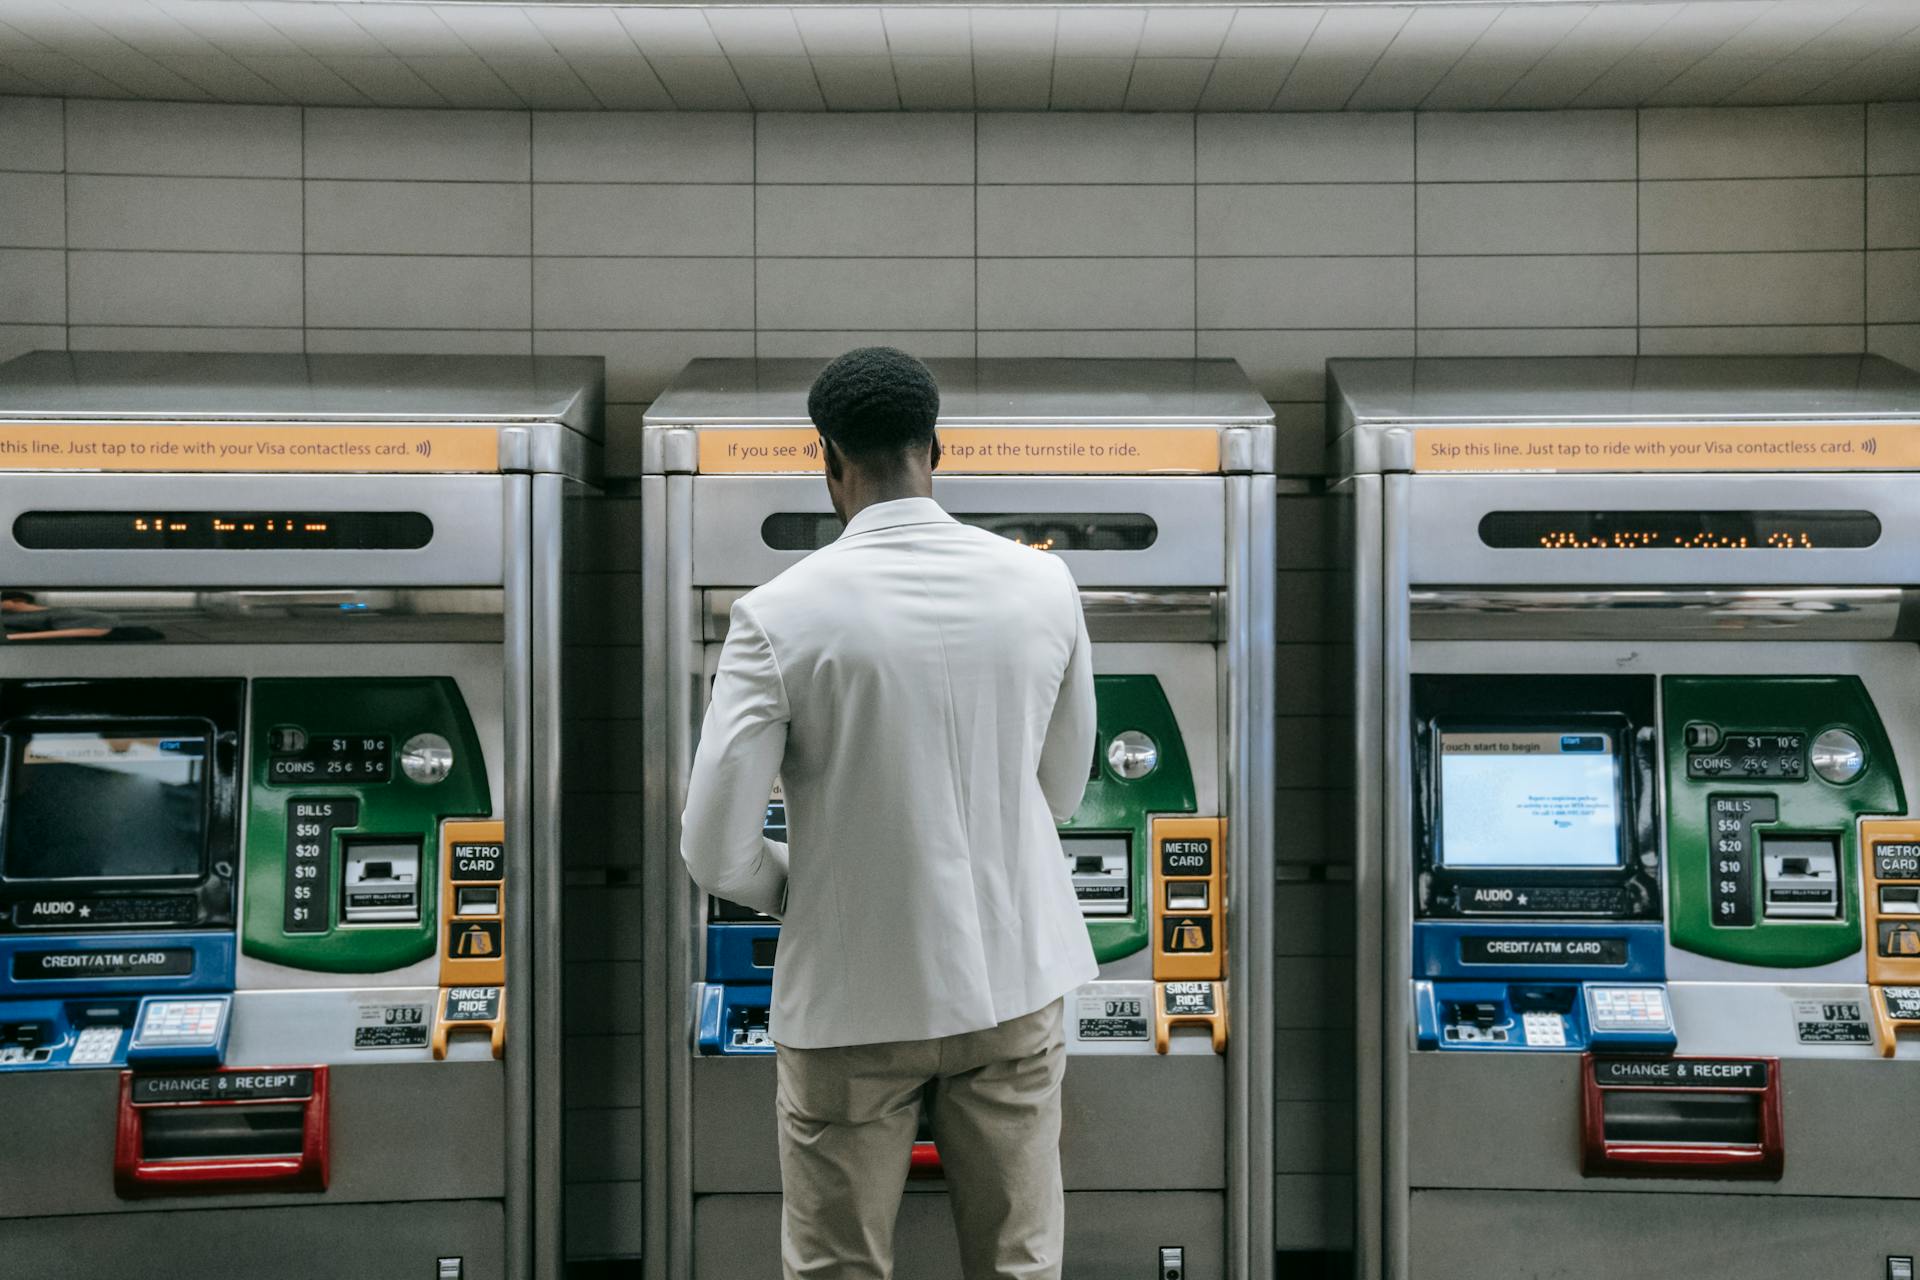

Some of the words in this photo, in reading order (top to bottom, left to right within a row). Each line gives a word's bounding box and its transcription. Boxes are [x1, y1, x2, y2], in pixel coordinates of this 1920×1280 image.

[0, 440, 28, 454] this
[33, 440, 63, 454] line.
[68, 441, 97, 454] Just
[102, 443, 126, 456] tap
[131, 443, 146, 454] to
[150, 441, 178, 454] ride
[182, 441, 215, 454] with
[220, 443, 252, 457] your
[256, 442, 285, 455] Visa
[289, 441, 371, 455] contactless
[375, 441, 409, 455] card.
[728, 444, 738, 456] If
[741, 447, 768, 460] you
[773, 447, 797, 456] see
[951, 444, 975, 459] tap
[979, 445, 992, 456] at
[997, 443, 1020, 456] the
[1025, 443, 1085, 456] turnstile
[1090, 445, 1104, 456] to
[1108, 443, 1140, 456] ride.
[1431, 443, 1461, 459] Skip
[1465, 443, 1490, 455] this
[1493, 443, 1523, 455] line.
[1526, 443, 1554, 455] Just
[1558, 443, 1581, 457] tap
[1585, 443, 1599, 455] to
[1603, 442, 1630, 455] ride
[1634, 441, 1665, 454] with
[1670, 443, 1702, 457] your
[1704, 441, 1732, 454] Visa
[1736, 440, 1816, 454] contactless
[1820, 440, 1855, 453] card.
[332, 739, 347, 751] $1
[1473, 742, 1496, 751] start
[1499, 743, 1510, 751] to
[1512, 742, 1540, 753] begin
[1747, 737, 1761, 748] $1
[276, 762, 314, 773] COINS
[1694, 758, 1732, 769] COINS
[297, 805, 332, 816] BILLS
[1717, 801, 1751, 811] BILLS
[296, 824, 320, 836] $50
[1718, 820, 1740, 831] $50
[296, 845, 319, 857] $20
[1165, 842, 1208, 854] METRO
[1719, 840, 1741, 852] $20
[1877, 845, 1920, 857] METRO
[455, 847, 499, 858] METRO
[459, 860, 495, 872] CARD
[1170, 855, 1203, 867] CARD
[1720, 861, 1740, 873] $10
[1882, 858, 1918, 870] CARD
[295, 865, 316, 878] $10
[294, 887, 311, 899] $5
[1720, 881, 1736, 893] $5
[1474, 889, 1513, 901] AUDIO
[33, 902, 75, 914] AUDIO
[293, 907, 308, 920] $1
[1721, 902, 1735, 914] $1
[1487, 941, 1561, 953] CREDIT/ATM
[1566, 942, 1601, 953] CARD
[42, 954, 123, 968] CREDIT/ATM
[129, 952, 166, 965] CARD
[451, 988, 497, 1000] SINGLE
[1166, 982, 1210, 994] SINGLE
[1176, 994, 1204, 1006] RIDE
[1897, 999, 1920, 1010] RID
[458, 1001, 488, 1012] RIDE
[1106, 1002, 1139, 1013] 0785
[1611, 1064, 1669, 1076] CHANGE
[1677, 1064, 1686, 1076] &
[1693, 1065, 1752, 1077] RECEIPT
[149, 1078, 211, 1092] CHANGE
[218, 1077, 228, 1089] &
[236, 1075, 296, 1089] RECEIPT
